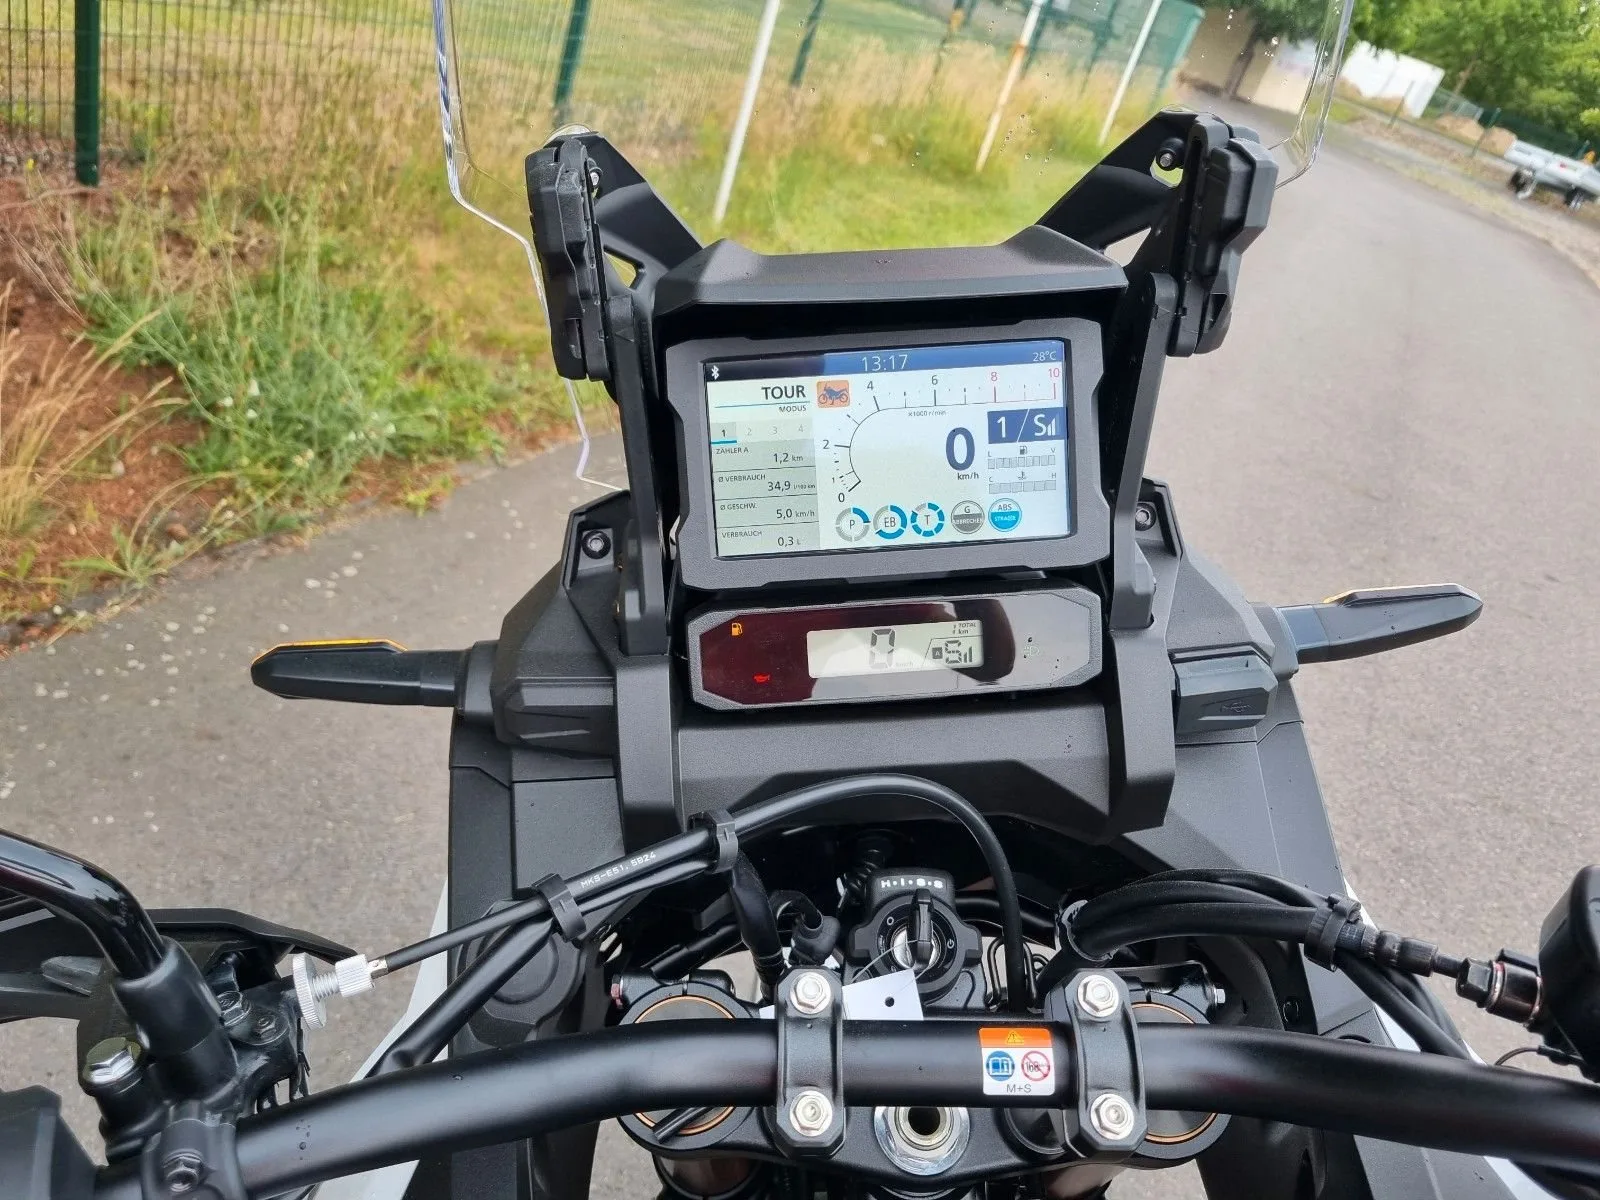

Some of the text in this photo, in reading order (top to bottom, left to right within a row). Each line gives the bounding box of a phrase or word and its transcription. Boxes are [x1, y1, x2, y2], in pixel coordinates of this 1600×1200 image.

[1032, 350, 1057, 362] 28°C
[861, 354, 908, 372] 13:17
[990, 372, 998, 382] 8
[1048, 368, 1060, 378] 10
[931, 375, 938, 386] 6
[866, 381, 874, 392] 4
[761, 385, 806, 400] TOUR
[778, 405, 807, 413] MODUS
[746, 428, 752, 436] 2
[773, 426, 778, 435] 3
[798, 424, 804, 433] 4
[996, 416, 1006, 438] 1
[822, 440, 830, 449] 2
[945, 426, 976, 472] 0
[773, 452, 789, 464] 1,2
[725, 474, 766, 482] VERBRAUCH
[957, 472, 980, 481] km/h
[767, 480, 791, 492] 34,9
[838, 492, 845, 503] 0
[964, 506, 971, 514] G
[997, 503, 1012, 511] ABS
[776, 509, 815, 520] 5,0 km/h
[924, 514, 931, 525] T
[849, 519, 856, 529] P
[884, 517, 896, 528] EB
[777, 536, 794, 548] 0,3
[868, 628, 896, 670] 0
[1006, 1084, 1032, 1094] M+S
